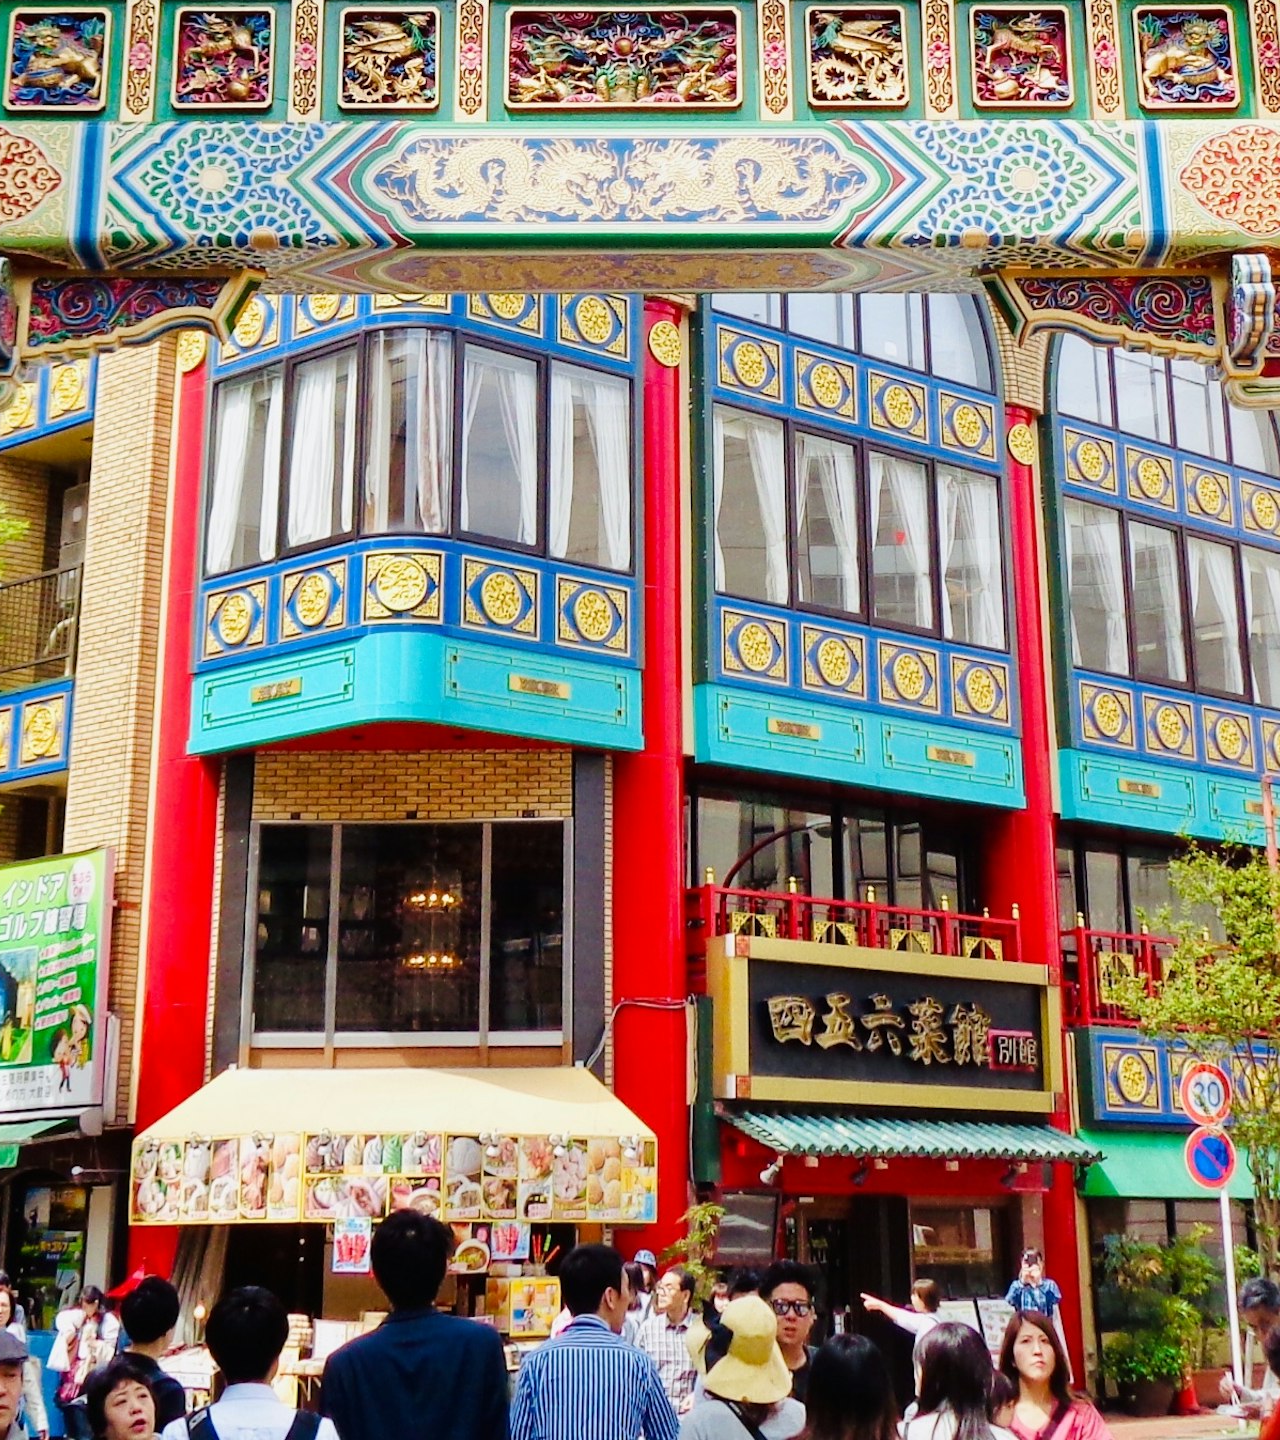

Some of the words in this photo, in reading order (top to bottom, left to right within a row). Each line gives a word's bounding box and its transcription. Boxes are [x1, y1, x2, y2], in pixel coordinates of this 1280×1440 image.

[3, 872, 66, 909] インドア
[768, 992, 992, 1068] 四五六菜館
[998, 1035, 1037, 1066] 別館
